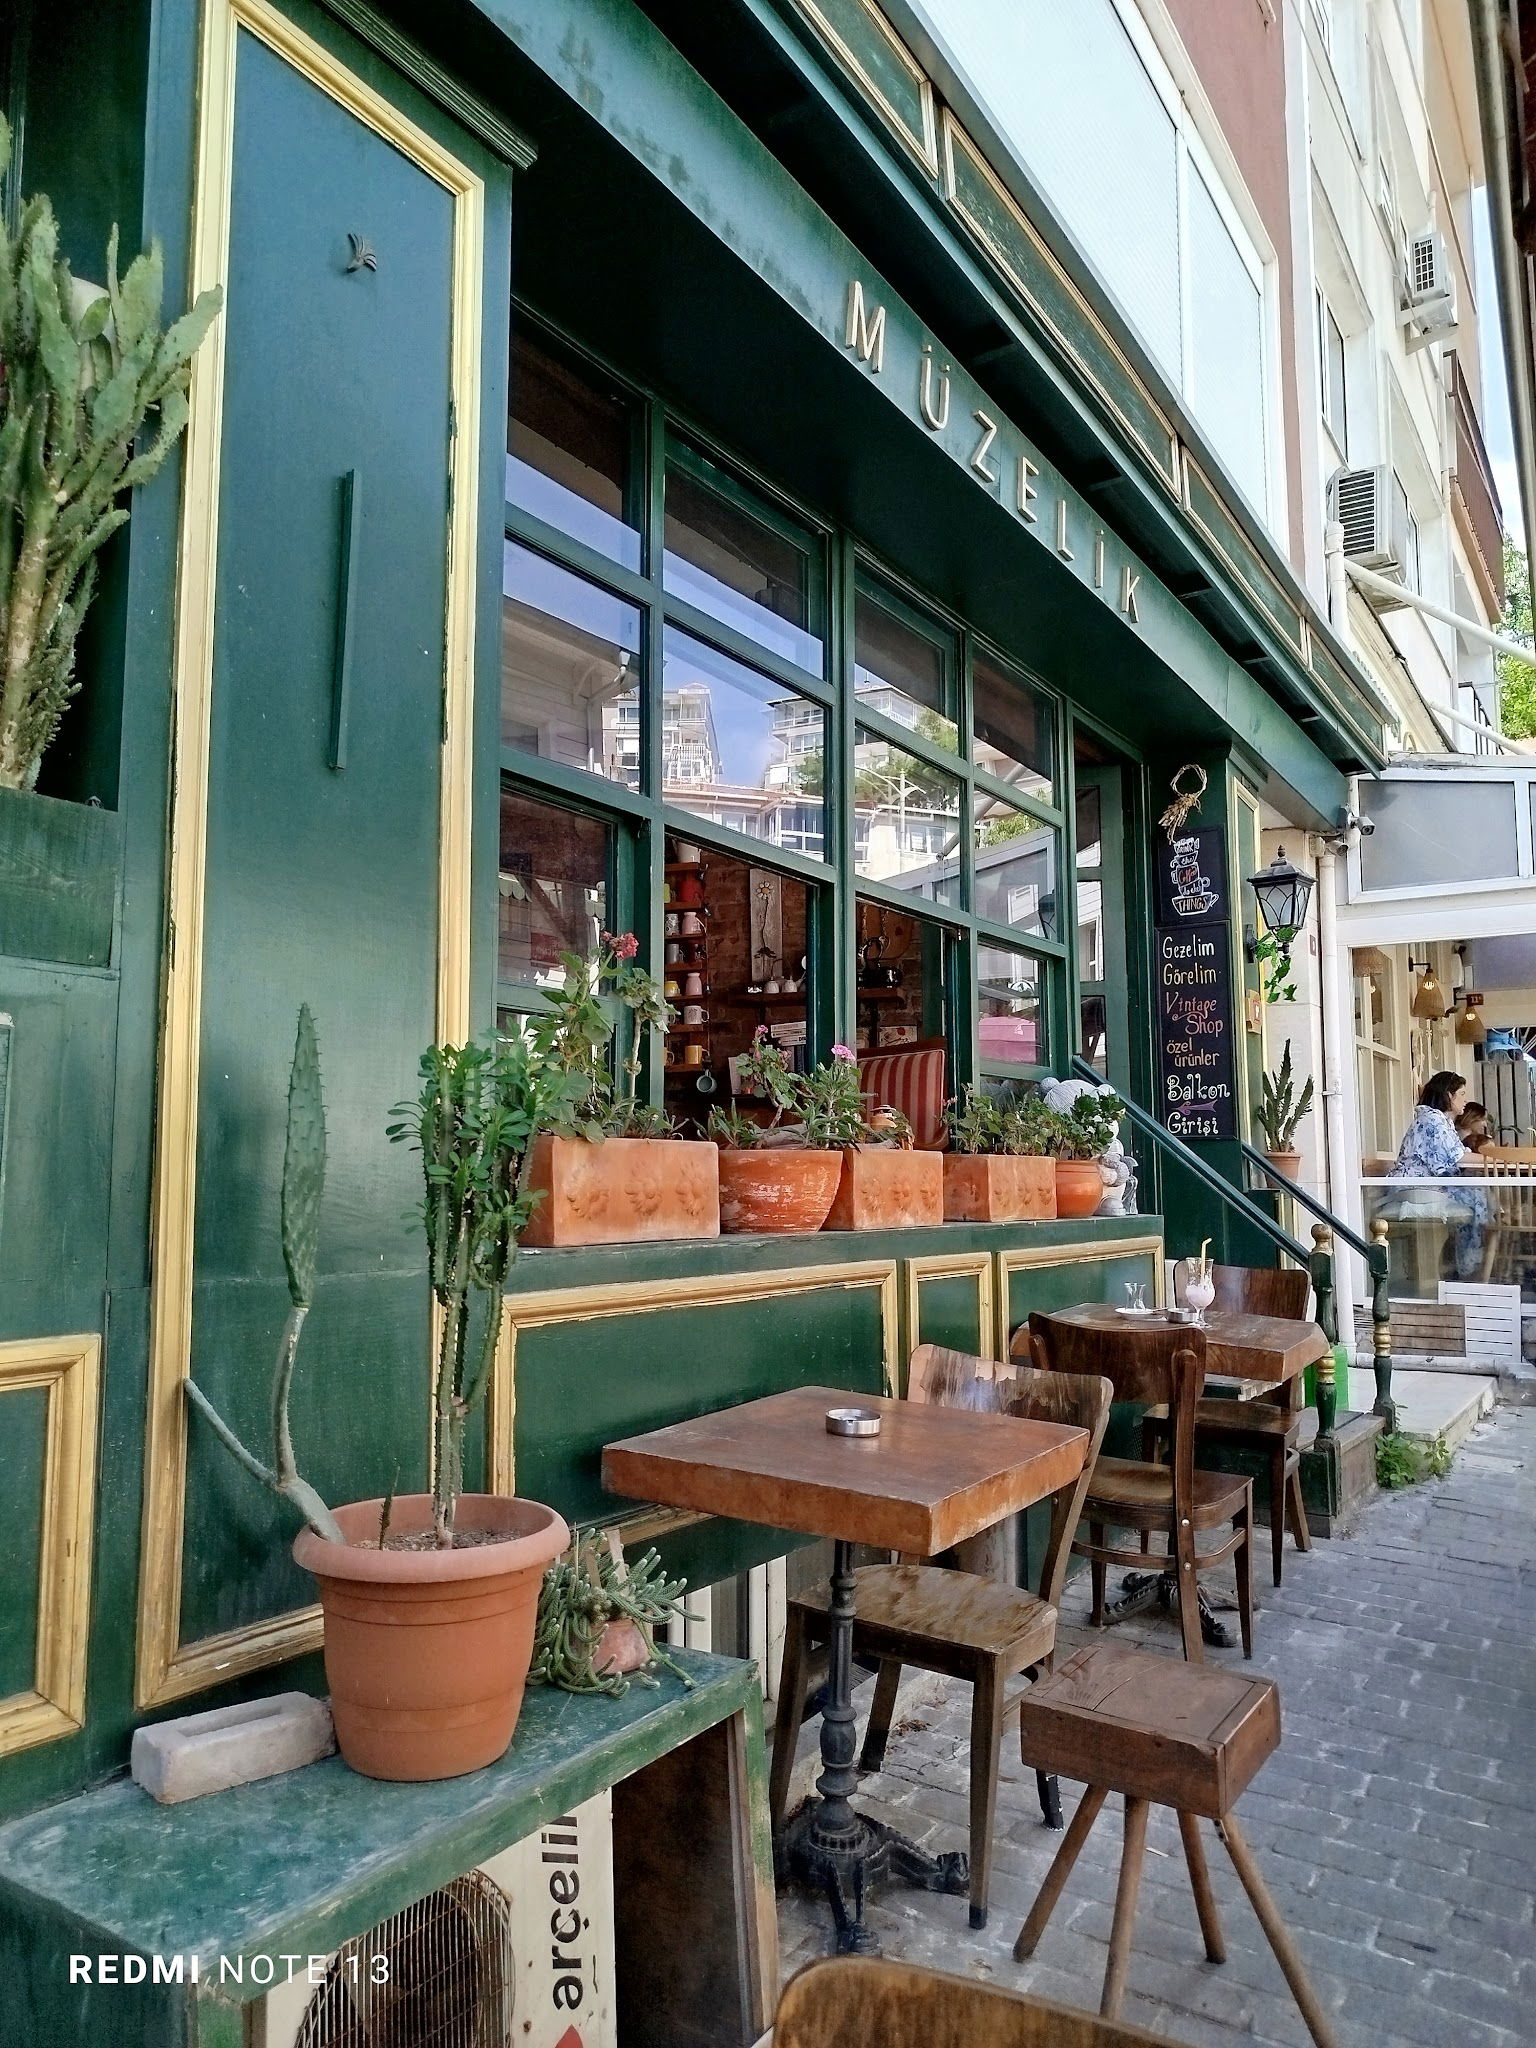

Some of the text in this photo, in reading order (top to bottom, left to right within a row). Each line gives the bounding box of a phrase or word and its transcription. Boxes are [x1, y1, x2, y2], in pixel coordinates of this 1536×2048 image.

[845, 280, 1140, 623] MÜZELİK
[1176, 896, 1208, 912] THINGS
[1163, 934, 1215, 959] Gezelim
[1163, 963, 1217, 986] Görelim
[1166, 992, 1217, 1018] Vintage
[1185, 1015, 1224, 1037] Shop
[1166, 1038, 1193, 1054] özel
[1174, 1052, 1220, 1067] ürünler
[1167, 1073, 1230, 1101] Balkon
[1167, 1112, 1219, 1136] Girişi
